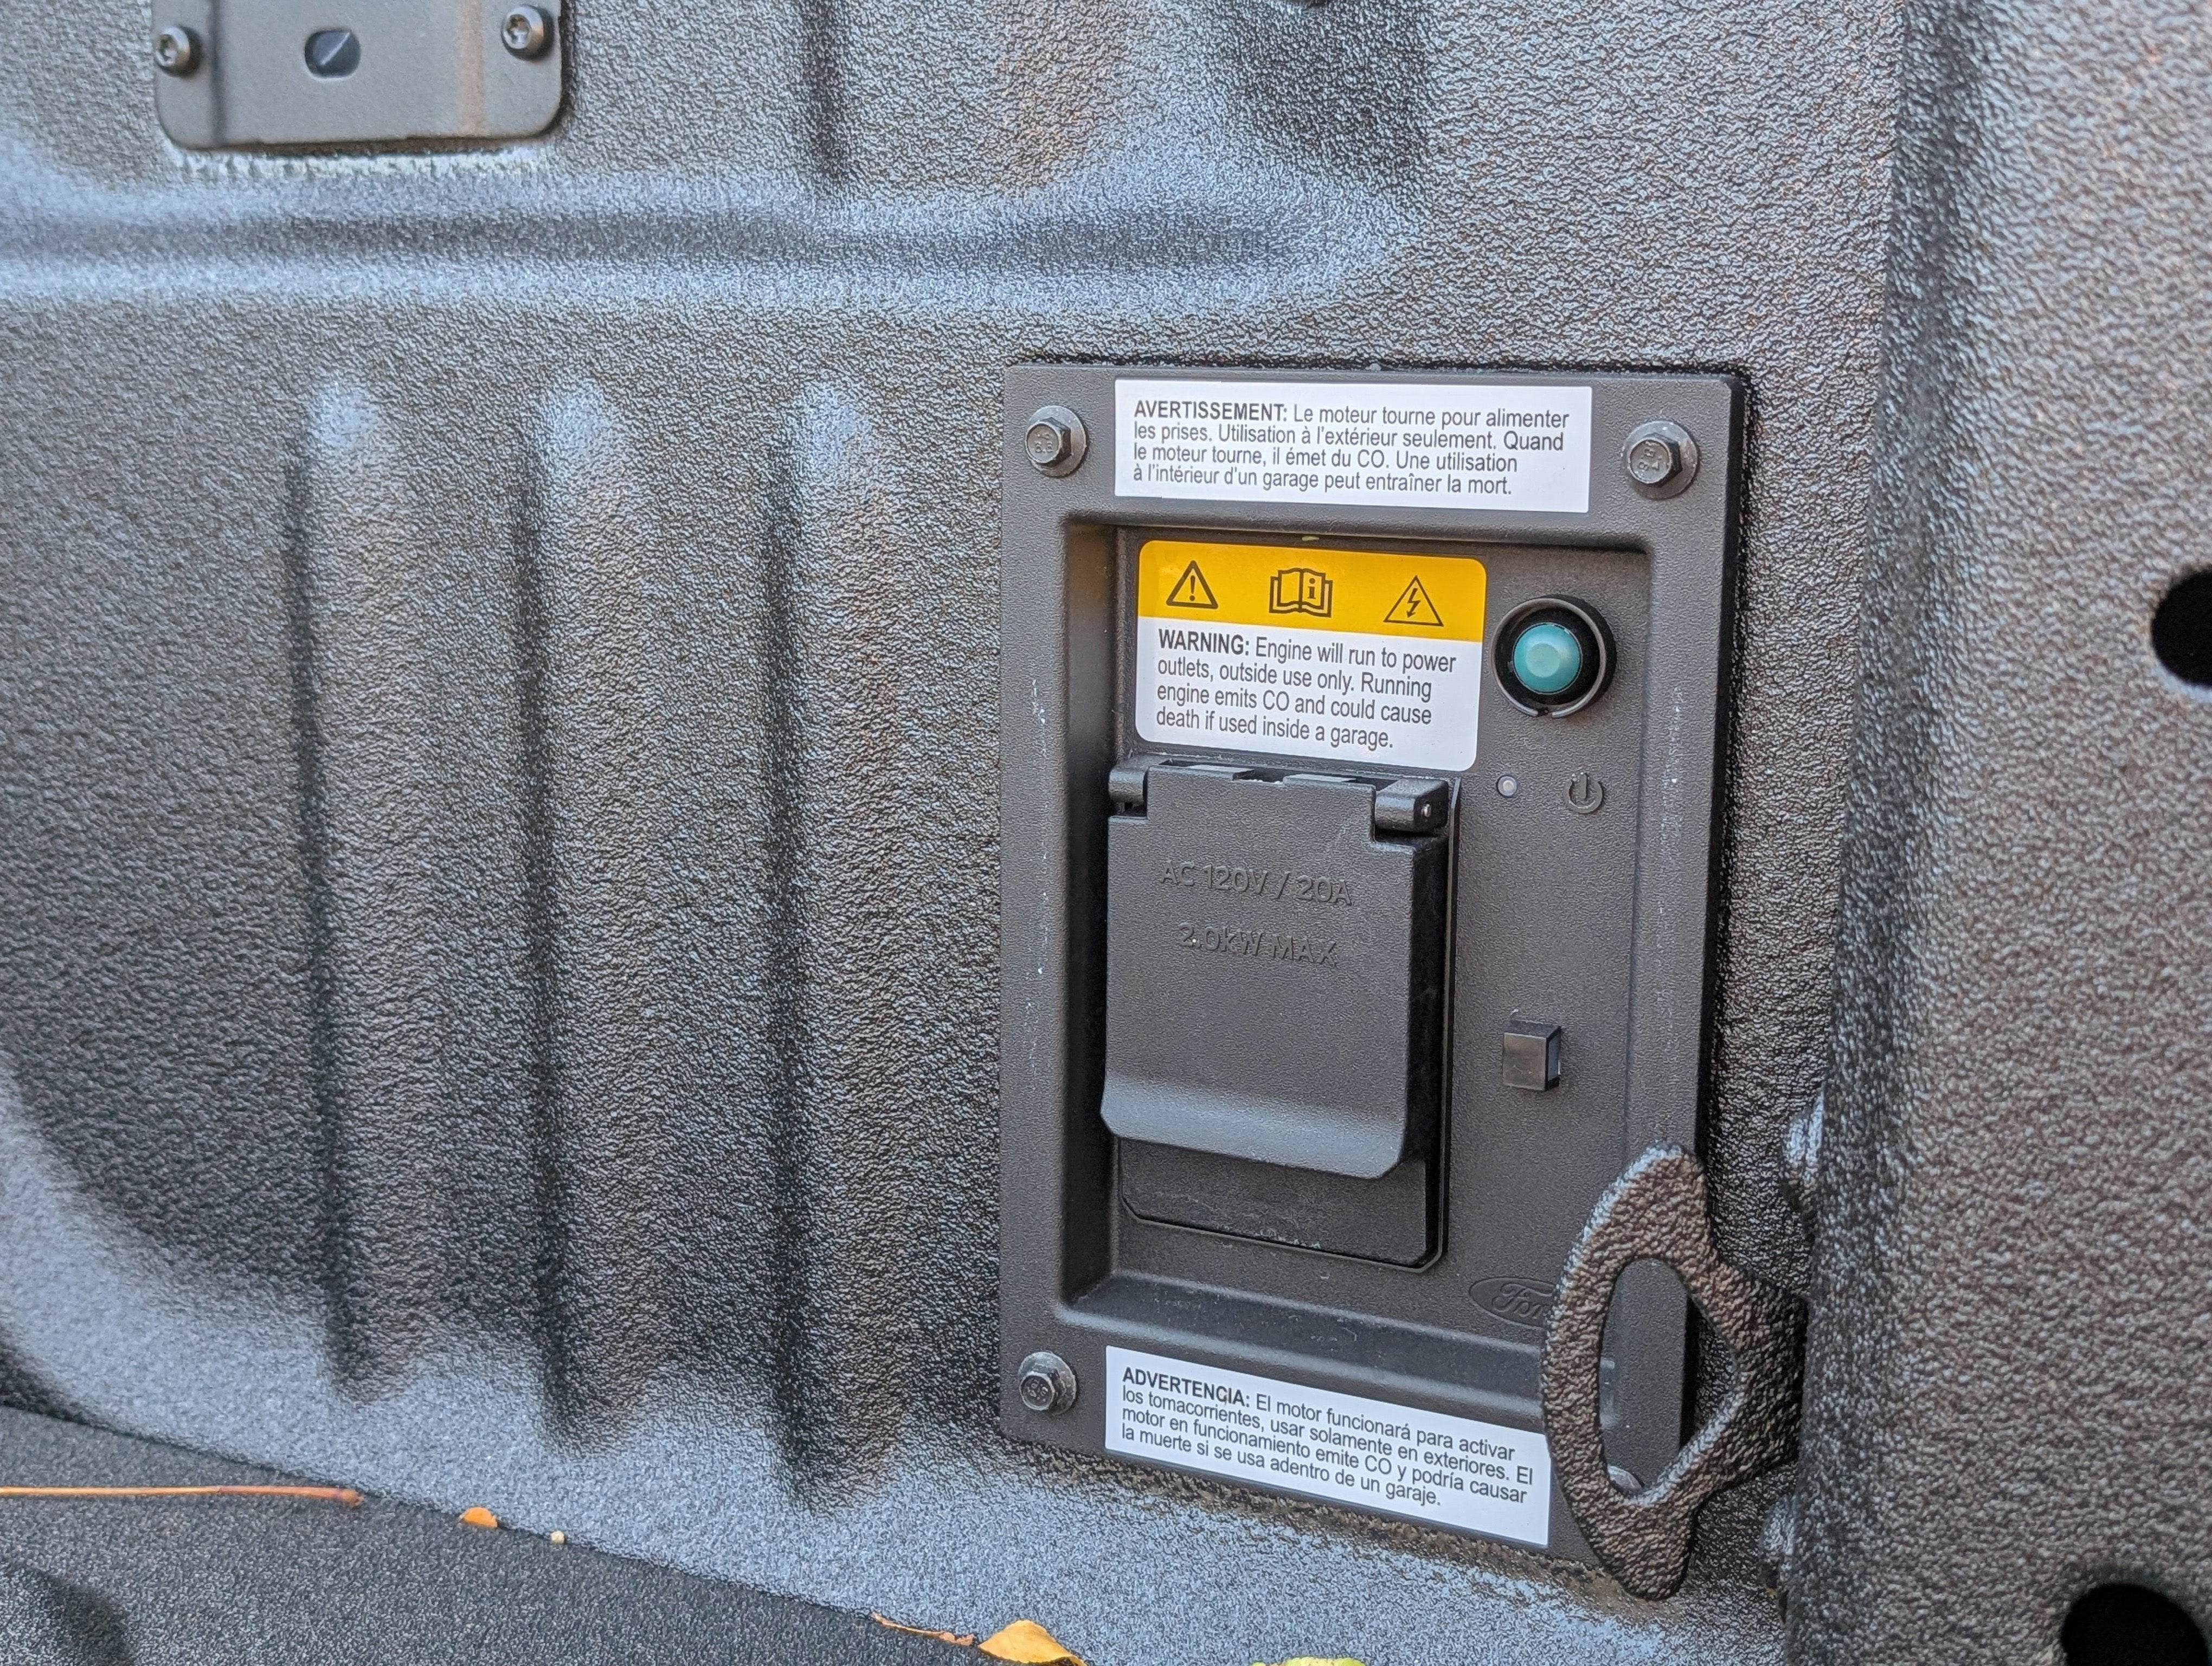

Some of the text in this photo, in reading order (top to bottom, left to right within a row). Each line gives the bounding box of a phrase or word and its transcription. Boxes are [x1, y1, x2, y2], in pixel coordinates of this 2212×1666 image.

[1134, 400, 1570, 431] AVERTISSEMENT: Le moteur tourne pour alimenter
[1134, 421, 1156, 439] les
[1161, 422, 1212, 444] prises.
[1219, 423, 1295, 444] Utilisation
[1301, 426, 1311, 444] à
[1403, 428, 1496, 450] seulement.
[1503, 430, 1564, 451] Quand
[1133, 463, 1142, 481] à
[1263, 472, 1319, 492] garage
[1324, 472, 1361, 493] peut
[1365, 472, 1443, 492] entraîner
[1447, 473, 1461, 493] la
[1468, 476, 1512, 495] mort.
[1134, 442, 1517, 472] le moteur tourne, il émet du CO. Une utilisation
[1158, 628, 1457, 675] WARNING: Engine will run to power
[1158, 656, 1432, 703] outlets, outside use only. Running
[1157, 682, 1432, 725] engine emits CO and could cause
[1156, 706, 1393, 751] death if used inside a garage.
[1161, 861, 1353, 906] AC 120V / 20A
[1272, 933, 1338, 967] MAX
[1491, 1283, 1554, 1319] For
[1122, 1366, 1516, 1461] ADVERTENCIA: El motor funcionará para activar
[1123, 1385, 1533, 1485] los tomacorrientes, usar solamente en exteriores. El
[1122, 1407, 1527, 1503] motor en funcionamiento emite CO y podría causar
[1122, 1422, 1441, 1507] la muerte si se usa adentro de un garaje.
